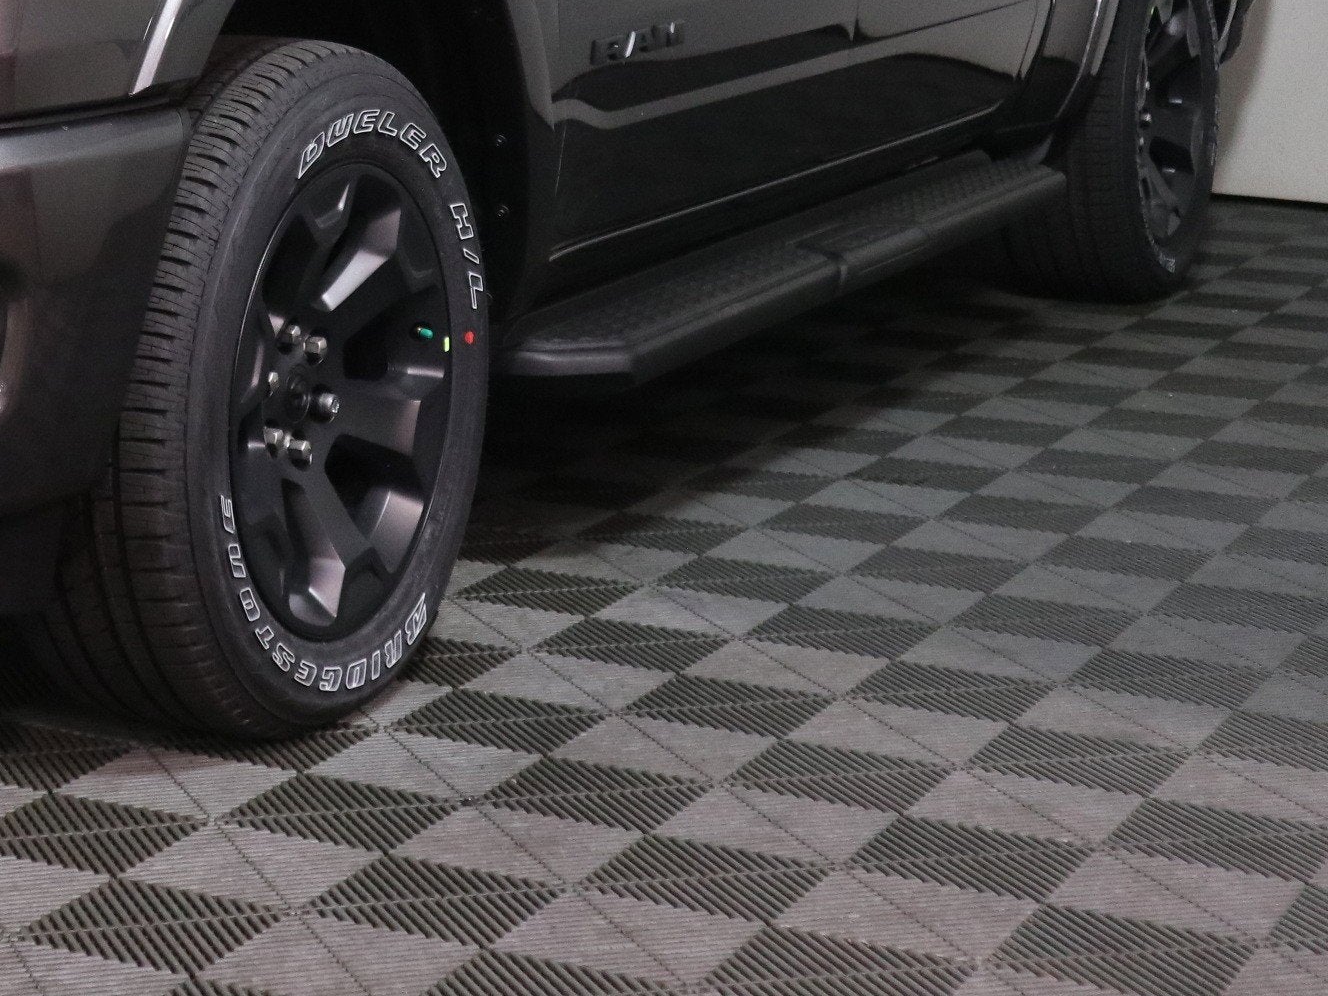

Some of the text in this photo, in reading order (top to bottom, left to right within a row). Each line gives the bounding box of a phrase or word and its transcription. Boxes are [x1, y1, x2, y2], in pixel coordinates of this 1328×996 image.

[297, 109, 484, 310] DUELER H/L
[220, 494, 428, 692] BRIDGESTONE
